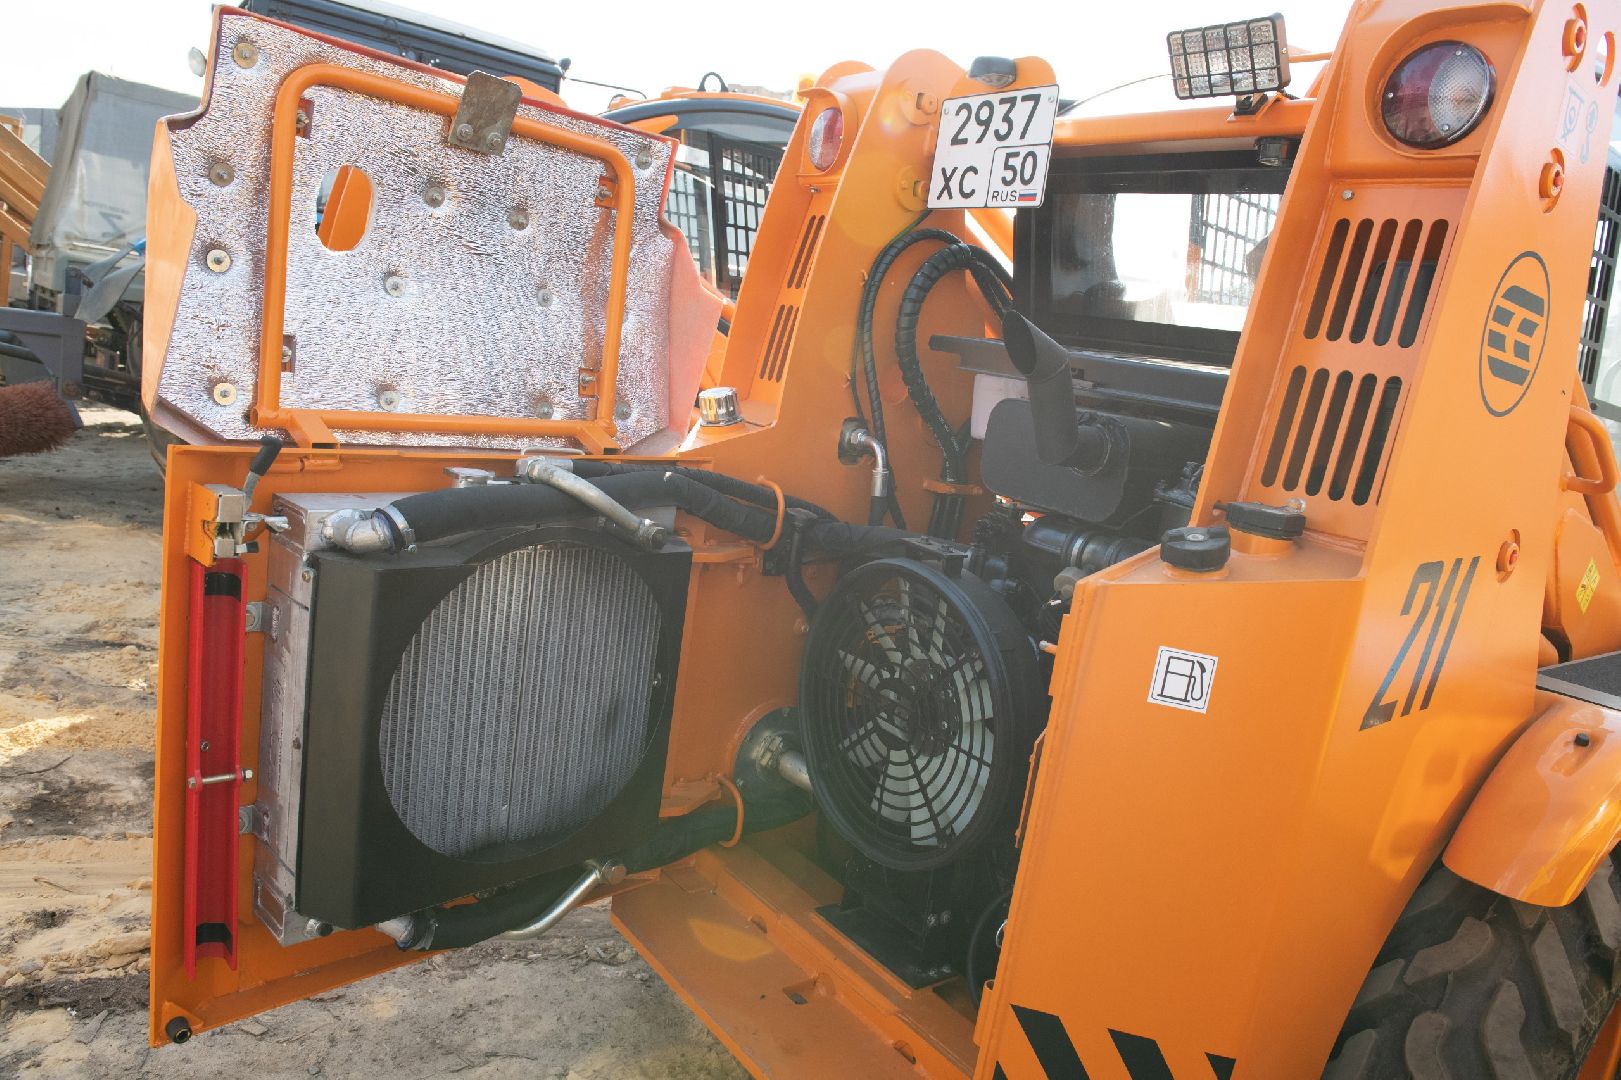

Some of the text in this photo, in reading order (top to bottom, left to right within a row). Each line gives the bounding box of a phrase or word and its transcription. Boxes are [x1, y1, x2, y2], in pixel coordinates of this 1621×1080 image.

[950, 93, 1042, 147] 2937
[1000, 150, 1038, 187] 50
[991, 190, 1017, 202] RUS
[1359, 555, 1481, 732] 211
